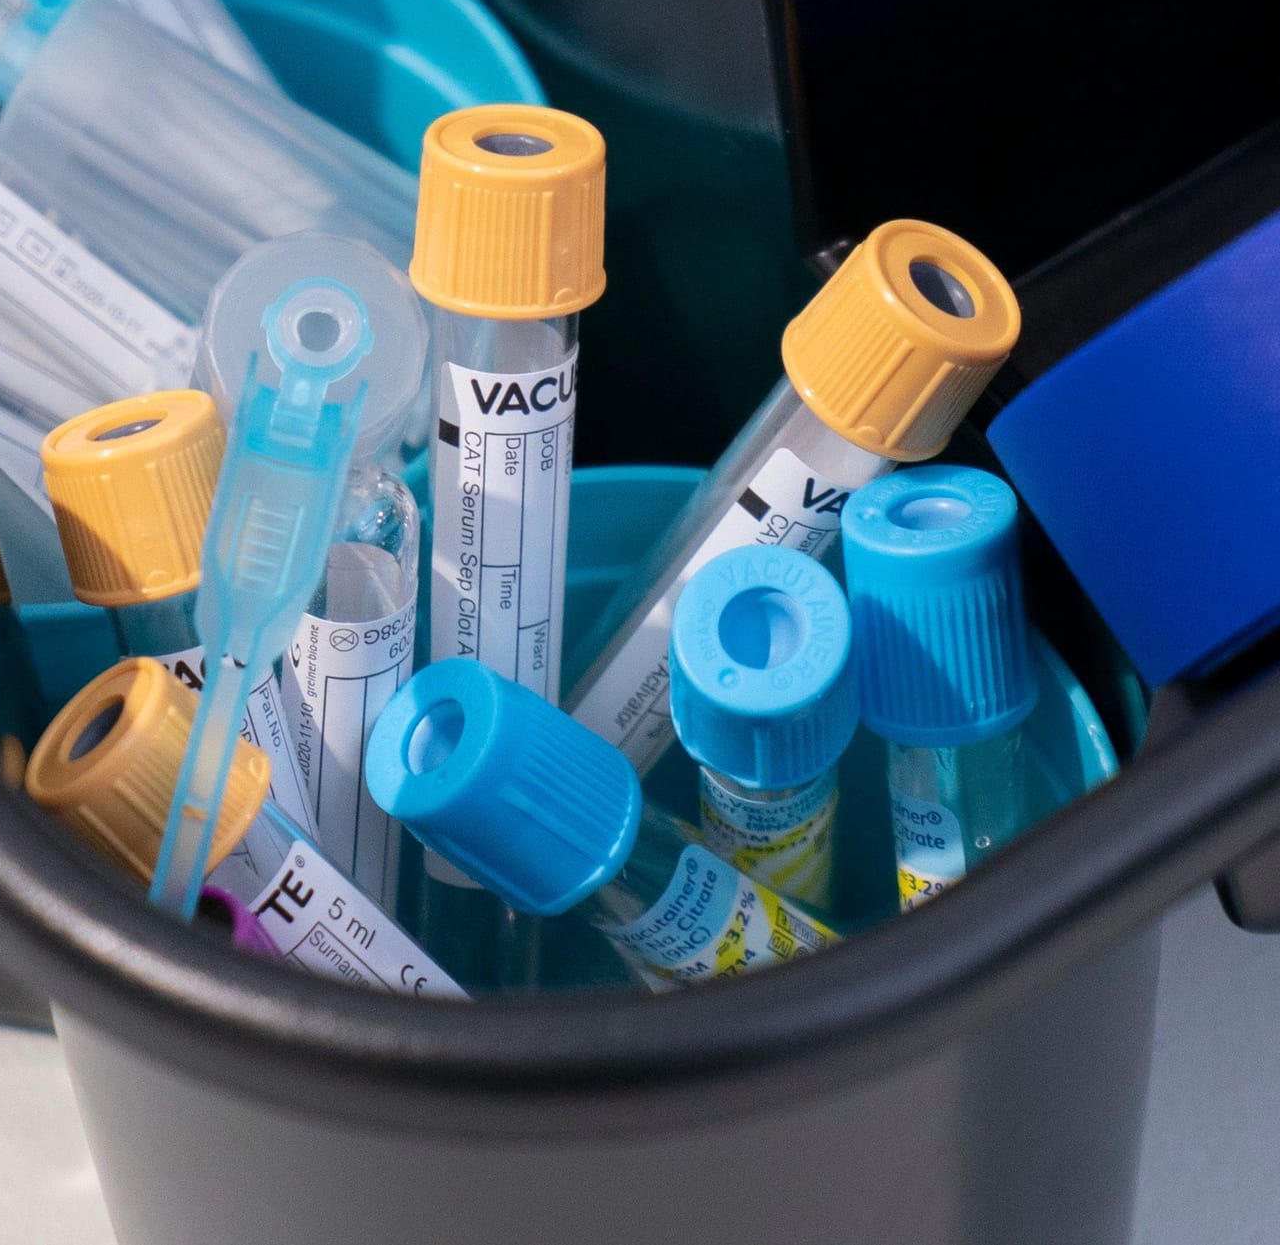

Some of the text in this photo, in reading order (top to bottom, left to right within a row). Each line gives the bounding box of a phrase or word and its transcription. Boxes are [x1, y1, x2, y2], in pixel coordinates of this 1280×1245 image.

[464, 431, 482, 477] CAT
[504, 437, 521, 476] Date
[540, 430, 555, 472] DOB
[461, 481, 481, 546] Serum
[456, 552, 478, 591] Sep
[500, 570, 517, 610] Time
[457, 597, 477, 637] Clot
[532, 626, 547, 671] Ward
[306, 660, 318, 698] greiner
[616, 663, 670, 729] Activator
[677, 869, 718, 931] Citrate
[328, 896, 377, 950] 5 ml
[662, 926, 712, 963] (9NC)
